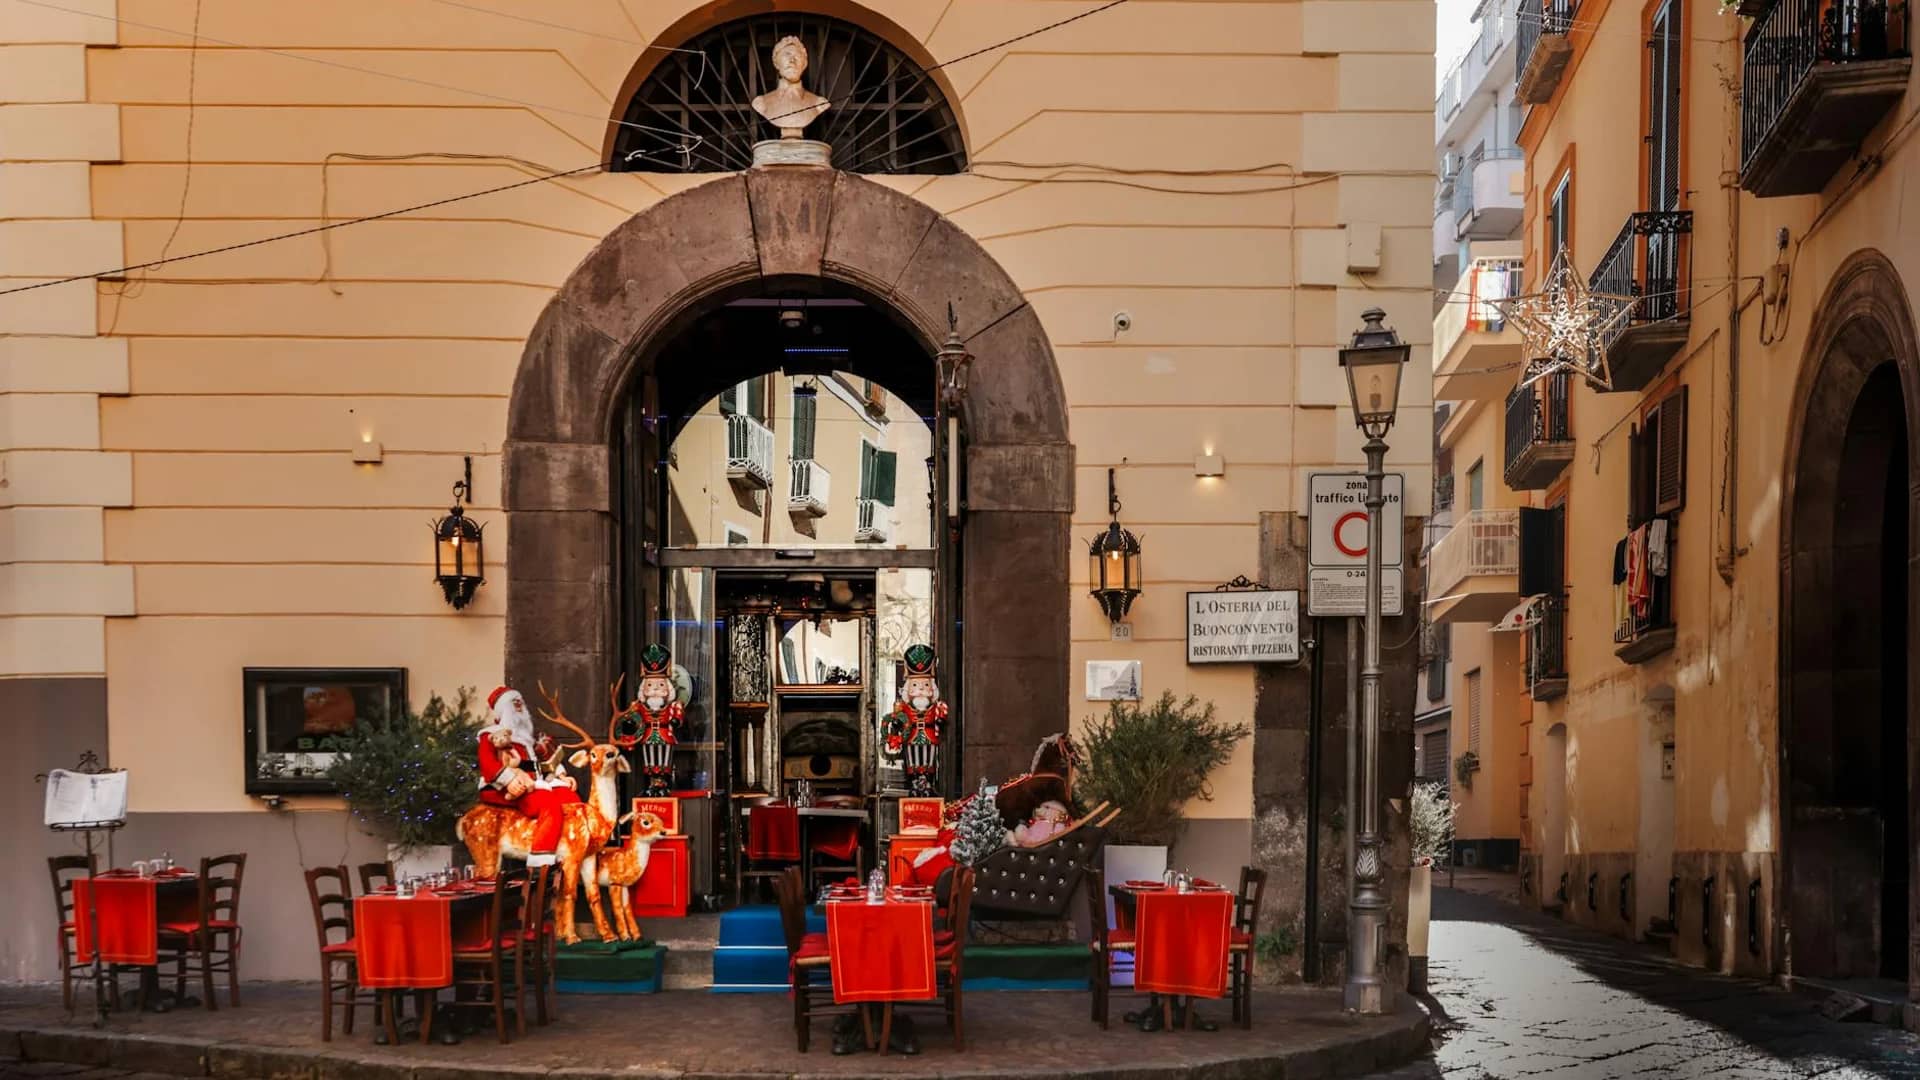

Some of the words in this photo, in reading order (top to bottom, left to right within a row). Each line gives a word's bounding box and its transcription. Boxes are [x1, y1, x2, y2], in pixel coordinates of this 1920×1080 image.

[1346, 481, 1368, 490] zona
[1315, 492, 1354, 503] traffico
[1358, 492, 1399, 503] liato
[1266, 600, 1290, 612] DEL
[1193, 623, 1294, 636] BUONCONVENTO
[1193, 644, 1249, 657] RISTORANTE
[1251, 643, 1293, 655] PIZZERIA
